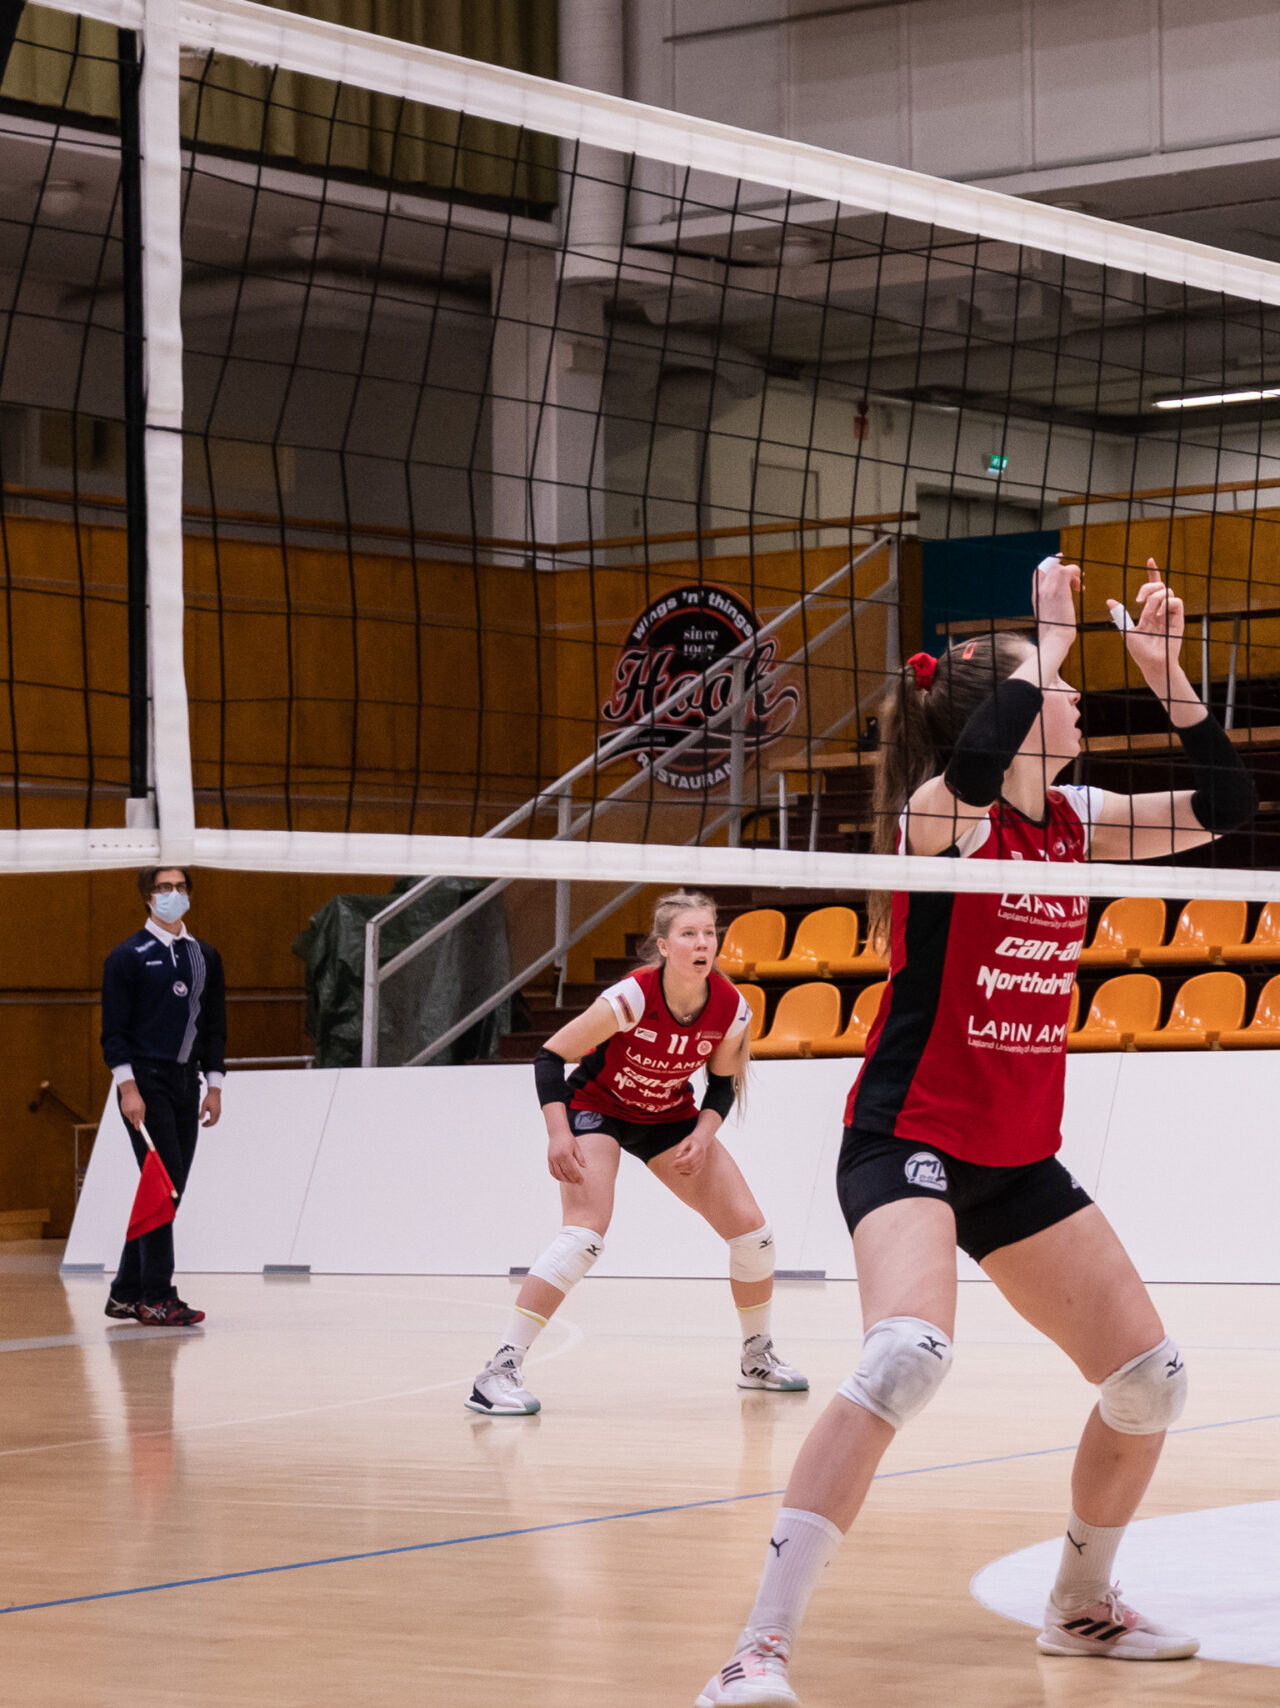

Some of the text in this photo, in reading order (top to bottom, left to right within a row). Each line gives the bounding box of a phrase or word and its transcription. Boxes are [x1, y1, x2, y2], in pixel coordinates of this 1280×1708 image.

[708, 592, 753, 638] things
[683, 626, 719, 640] since
[636, 752, 733, 789] RSTAURAN
[968, 1015, 1033, 1043] LAPIN
[667, 1034, 689, 1055] 11
[626, 1046, 670, 1070] LAPIN
